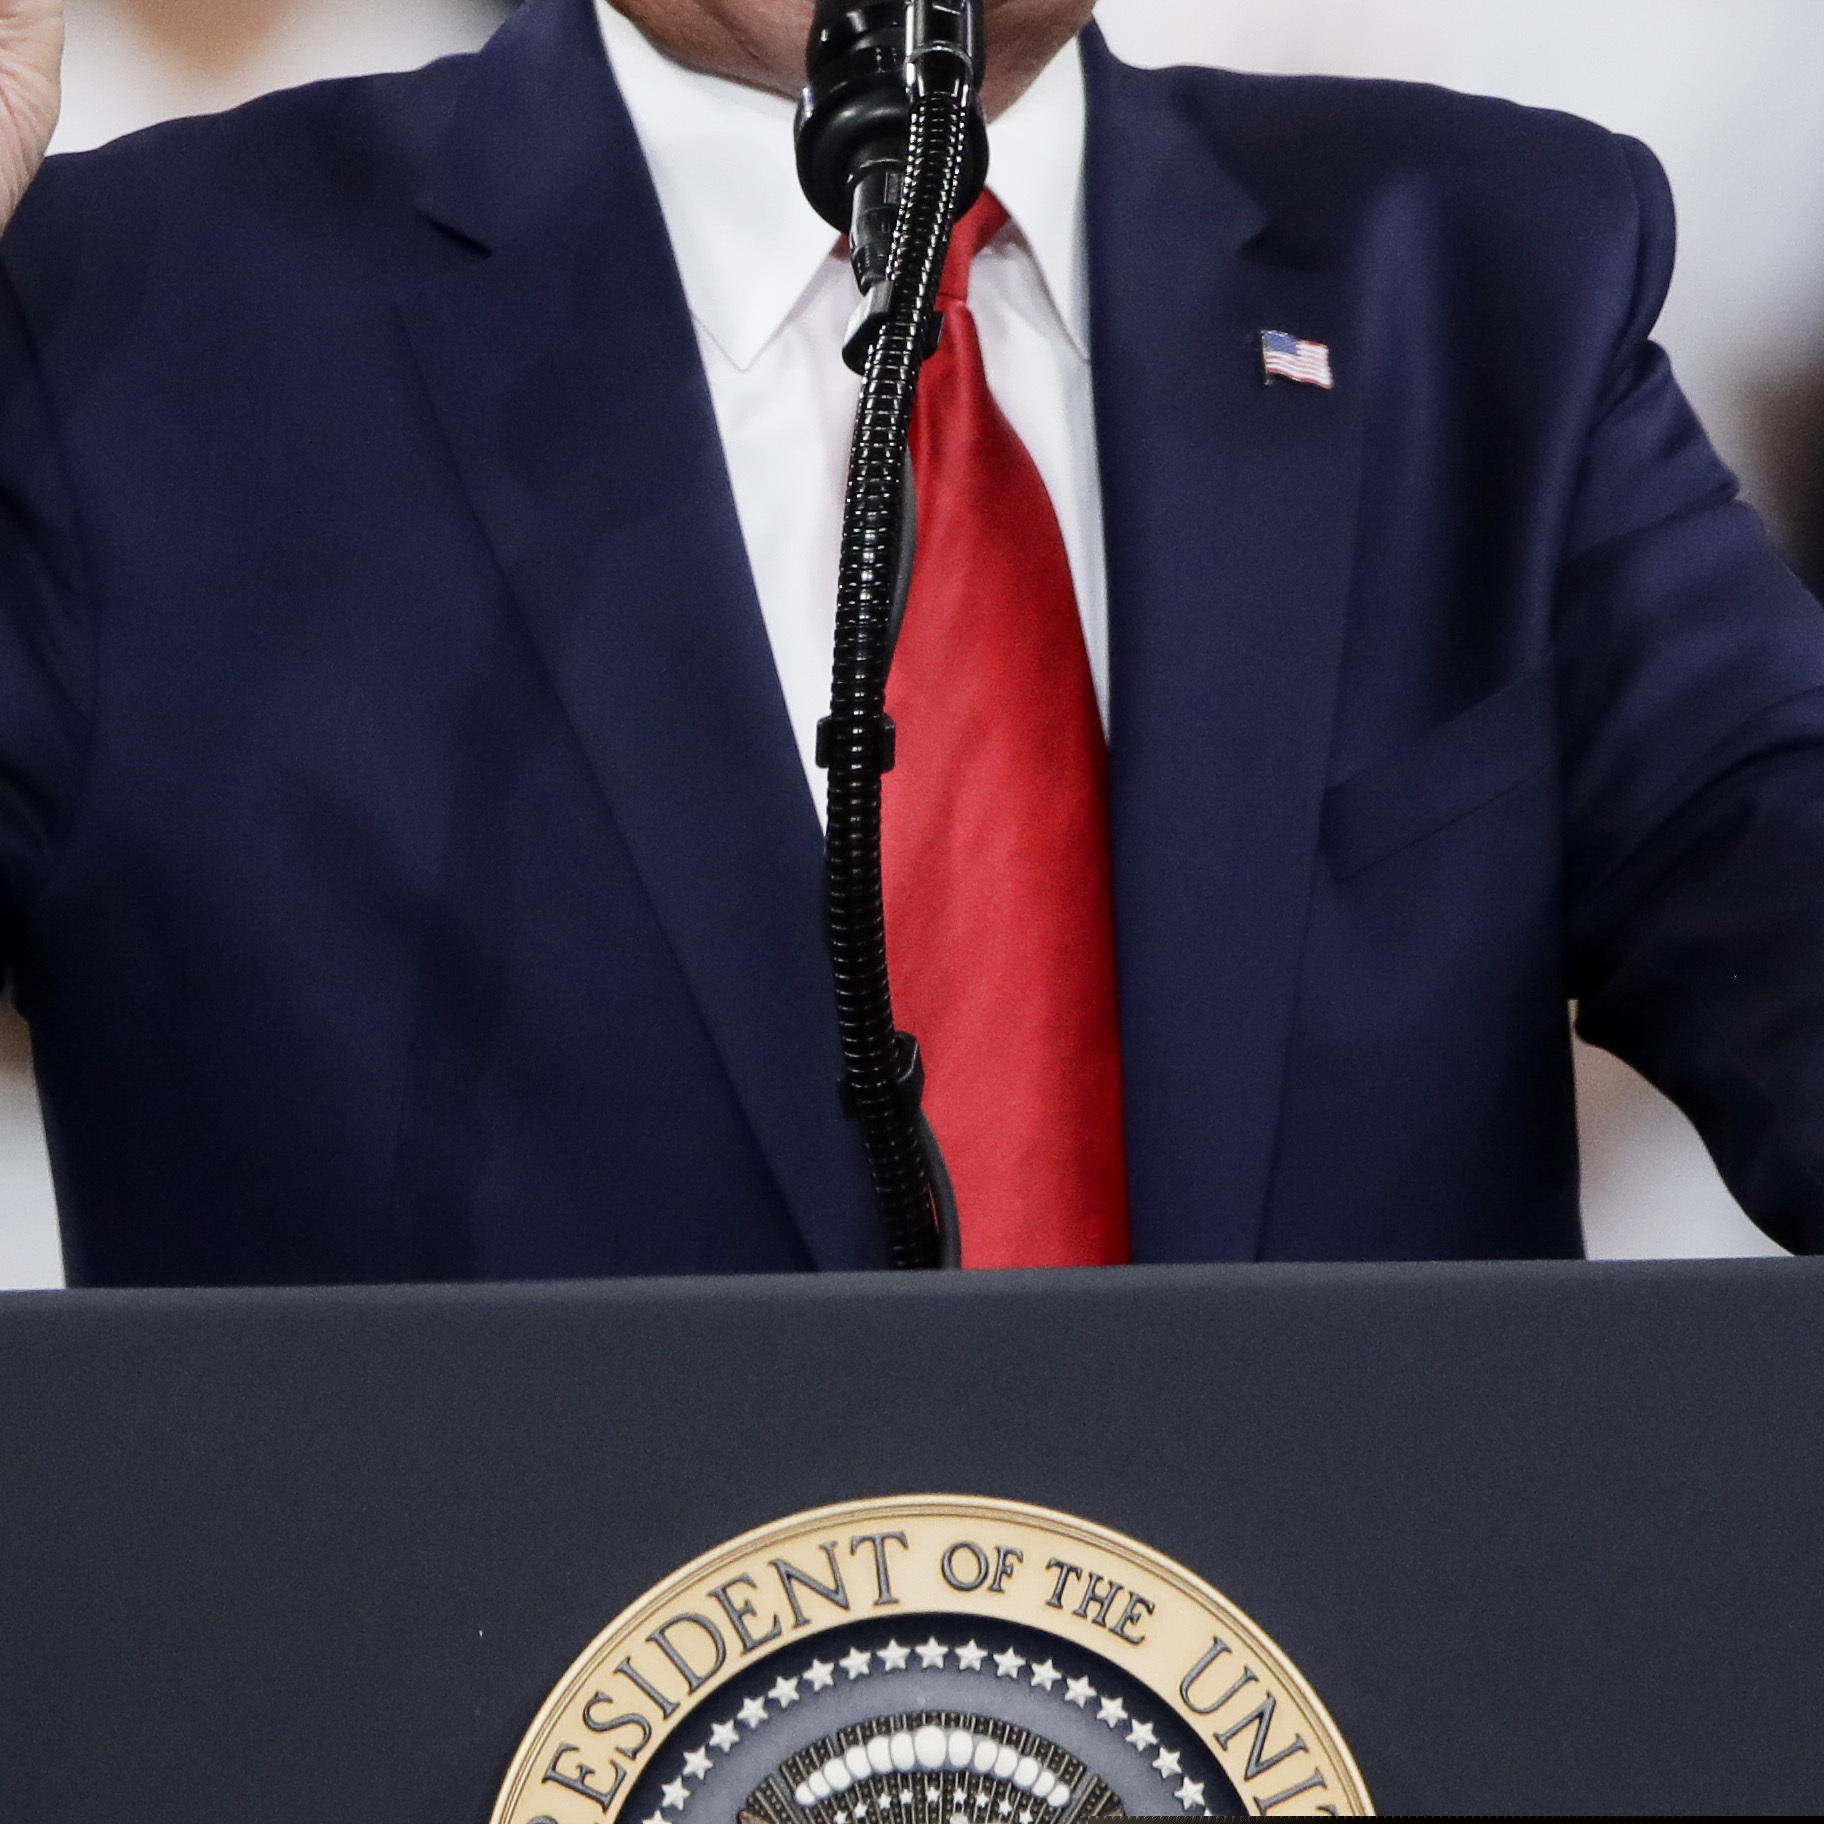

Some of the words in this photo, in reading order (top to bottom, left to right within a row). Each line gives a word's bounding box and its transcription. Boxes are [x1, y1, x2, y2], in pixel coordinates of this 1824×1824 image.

[524, 1530, 910, 1824] ESIDENT
[941, 1540, 1026, 1595] OF
[1045, 1560, 1156, 1645] THE
[1180, 1636, 1338, 1816] UNI
